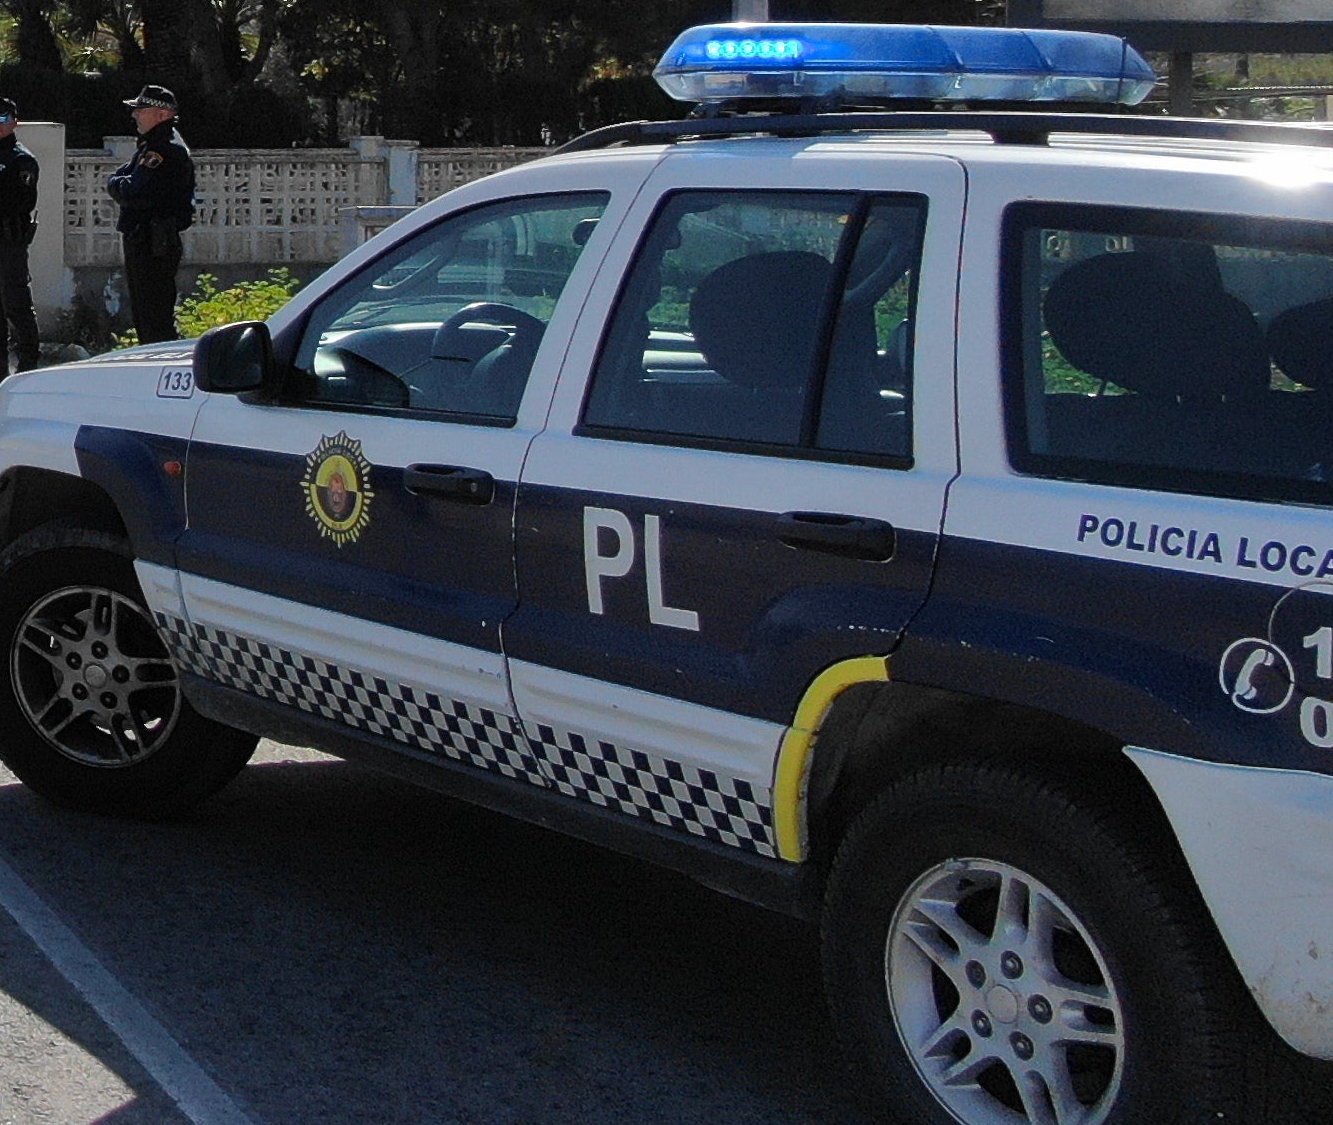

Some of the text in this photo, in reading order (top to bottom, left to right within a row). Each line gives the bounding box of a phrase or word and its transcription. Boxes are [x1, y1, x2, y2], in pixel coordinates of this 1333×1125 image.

[163, 372, 192, 391] 133
[1077, 514, 1222, 563] POLICIA
[584, 505, 700, 631] PL
